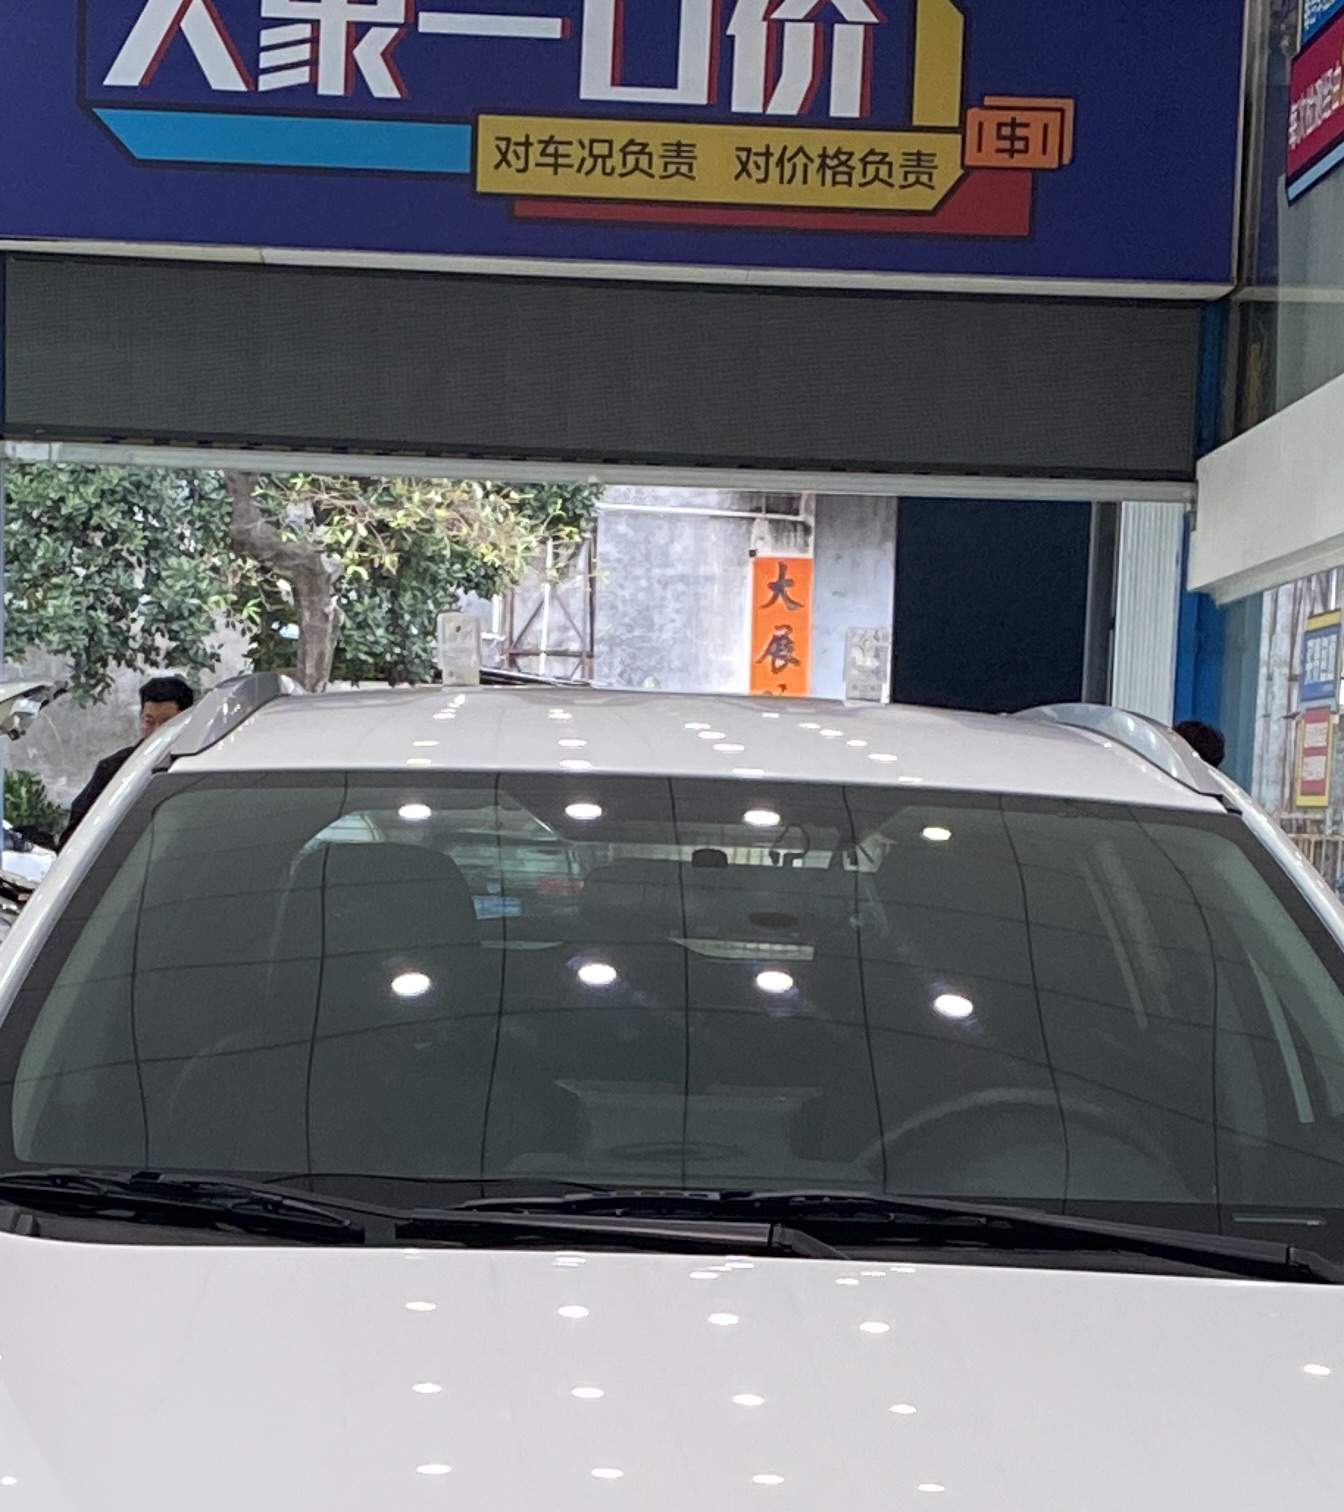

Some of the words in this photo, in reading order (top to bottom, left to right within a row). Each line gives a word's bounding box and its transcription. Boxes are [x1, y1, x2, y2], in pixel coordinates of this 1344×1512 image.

[493, 132, 698, 183] 对车况负责
[733, 143, 940, 191] 对价格负责
[756, 561, 805, 697] 大展
